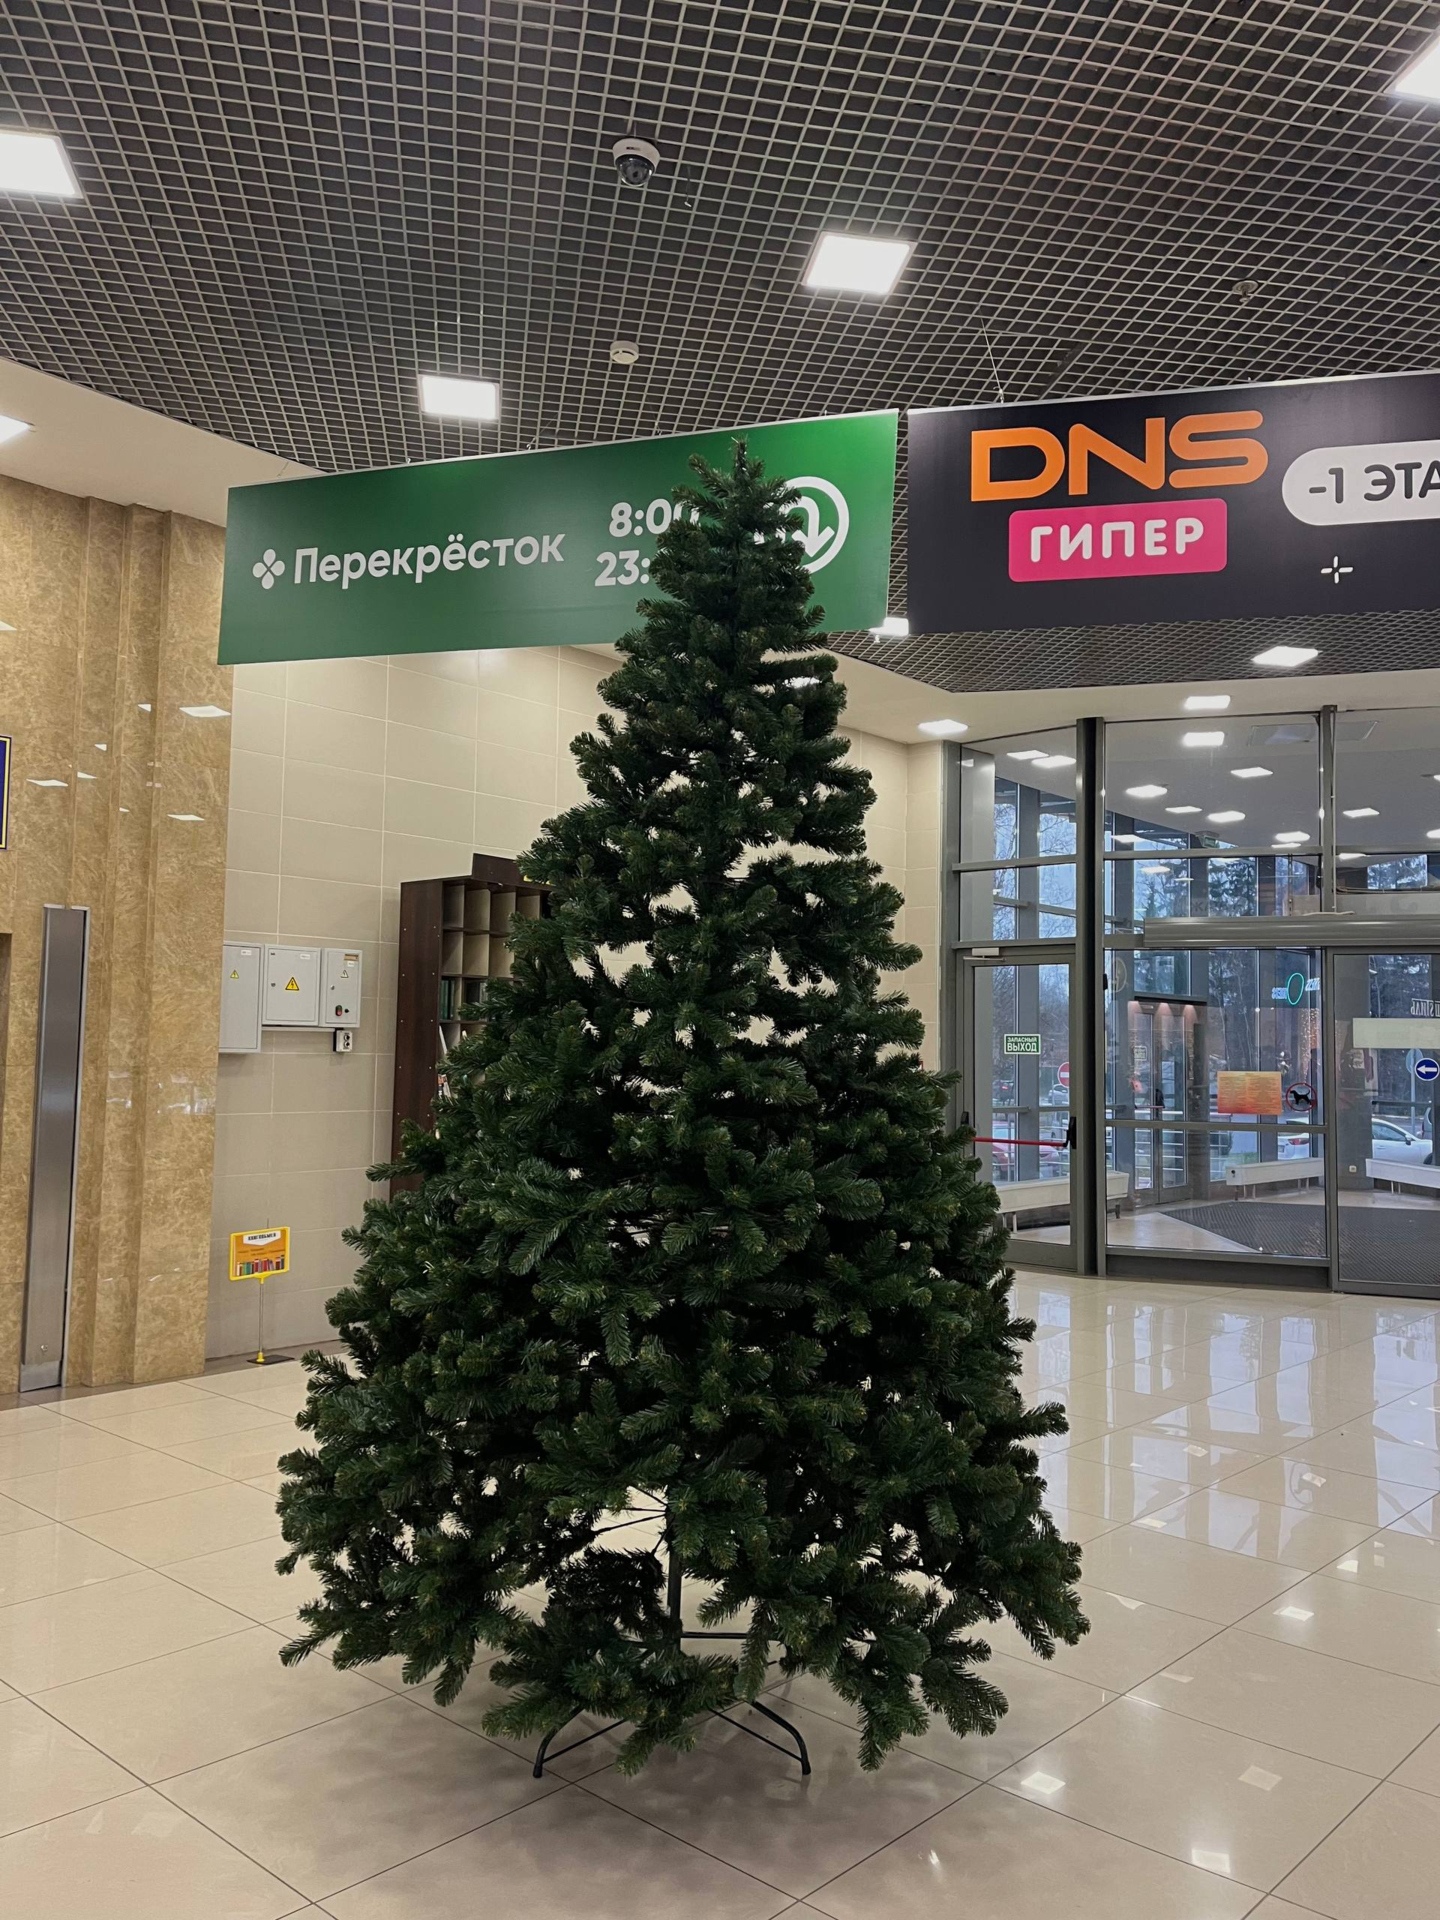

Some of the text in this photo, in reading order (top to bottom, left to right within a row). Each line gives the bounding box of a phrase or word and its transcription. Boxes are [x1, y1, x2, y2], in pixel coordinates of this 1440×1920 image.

[971, 410, 1268, 501] DNS
[1309, 467, 1344, 504] -1
[1030, 517, 1204, 563] ГИПЕР
[294, 533, 566, 589] Перекрёсток
[594, 550, 651, 587] 23:
[1007, 1042, 1038, 1052] ВЫХОД
